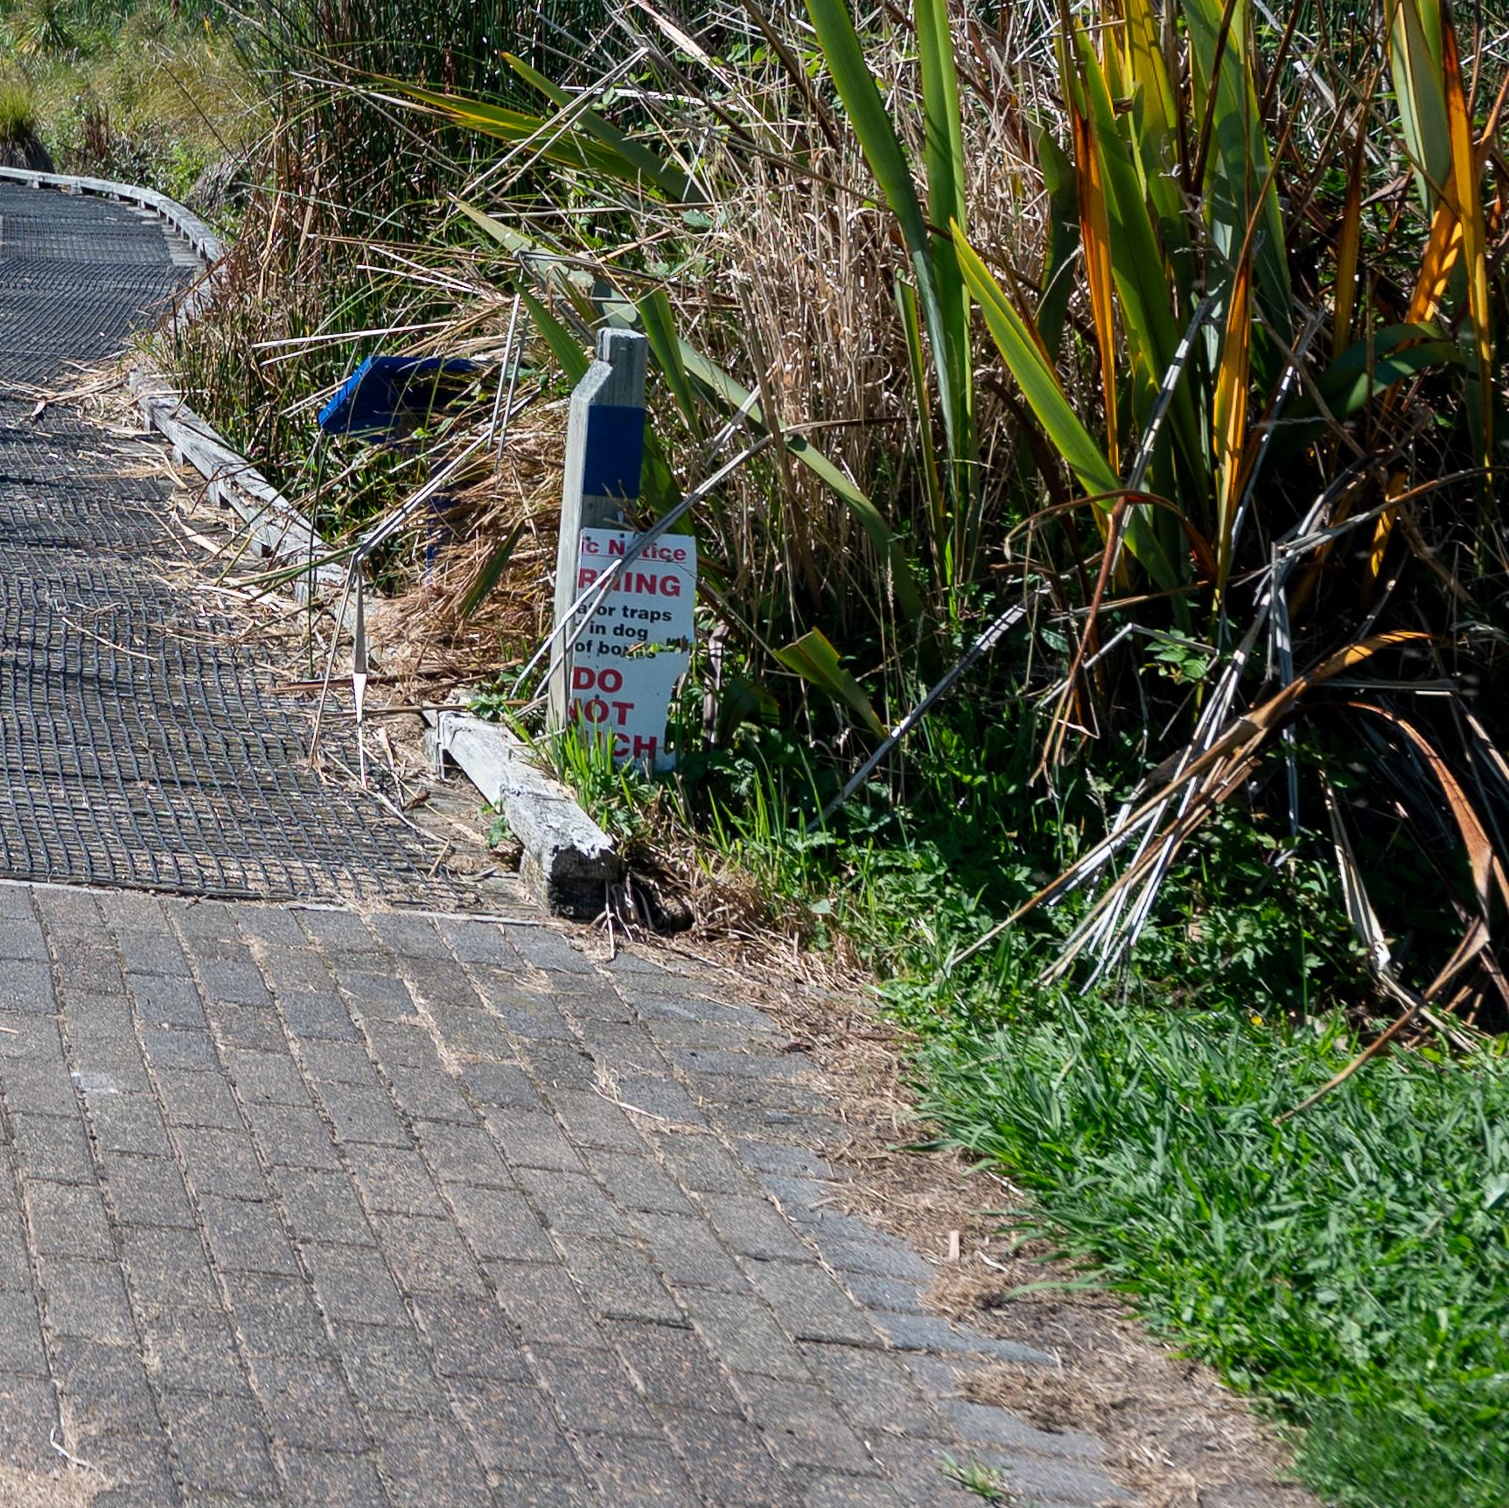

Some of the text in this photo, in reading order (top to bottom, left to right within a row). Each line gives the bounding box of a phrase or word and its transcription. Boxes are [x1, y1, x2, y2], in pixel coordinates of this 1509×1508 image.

[608, 539, 687, 561] Ntice
[622, 605, 673, 623] traps
[590, 621, 648, 641] in dog
[575, 640, 593, 652] of
[572, 666, 623, 693] DO
